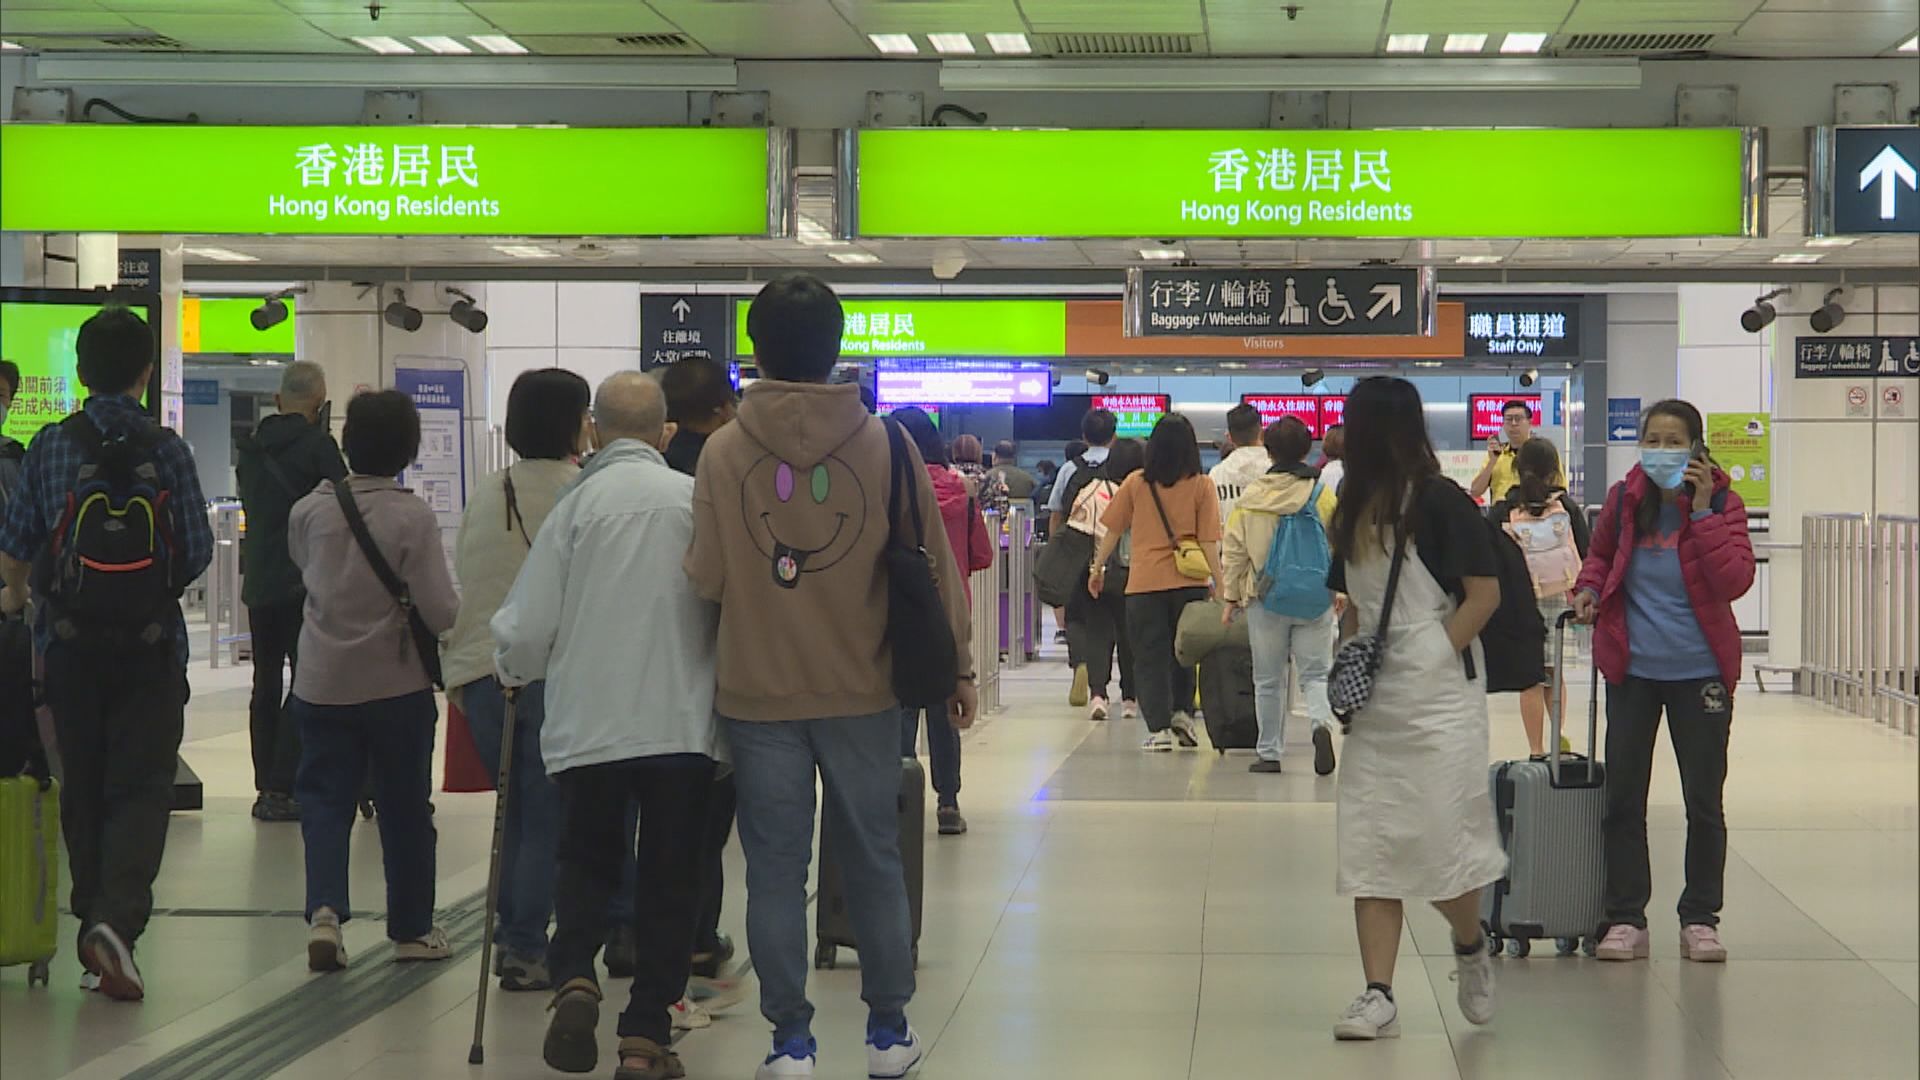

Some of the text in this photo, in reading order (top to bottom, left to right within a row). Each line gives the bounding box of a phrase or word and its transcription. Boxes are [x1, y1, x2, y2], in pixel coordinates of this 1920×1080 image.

[295, 142, 479, 187] 香港居民
[1207, 147, 1391, 192] 香港居民
[269, 195, 500, 220] Hong Kong Residents
[1181, 200, 1412, 225] Hong Kong Residents
[1150, 279, 1201, 308] 行李
[1220, 279, 1272, 308] 輪椅
[1151, 312, 1200, 329] Baggage
[1209, 312, 1271, 326] Wheelchair
[1469, 313, 1565, 338] 職員通道
[663, 330, 701, 344] 往離境
[872, 340, 925, 352] Residents
[1243, 337, 1284, 349] Visitors
[1488, 340, 1543, 356] Staff Only
[1801, 343, 1827, 360] 行李
